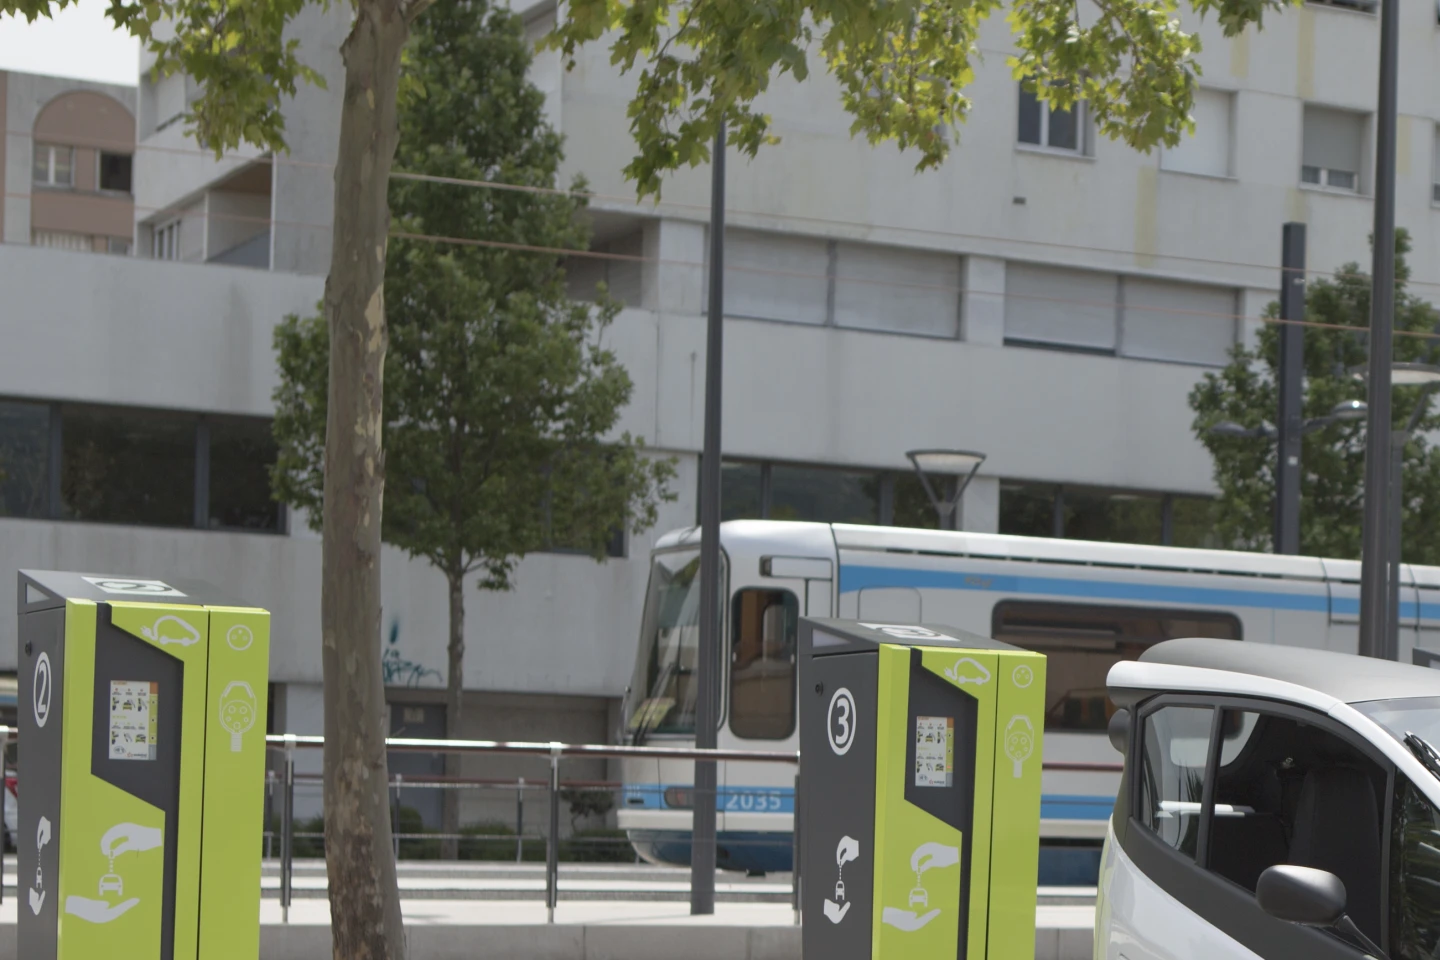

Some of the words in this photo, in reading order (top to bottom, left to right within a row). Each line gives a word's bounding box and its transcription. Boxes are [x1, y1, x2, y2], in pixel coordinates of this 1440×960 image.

[38, 661, 47, 713] 2
[835, 697, 850, 745] 3
[725, 789, 782, 810] 2035
